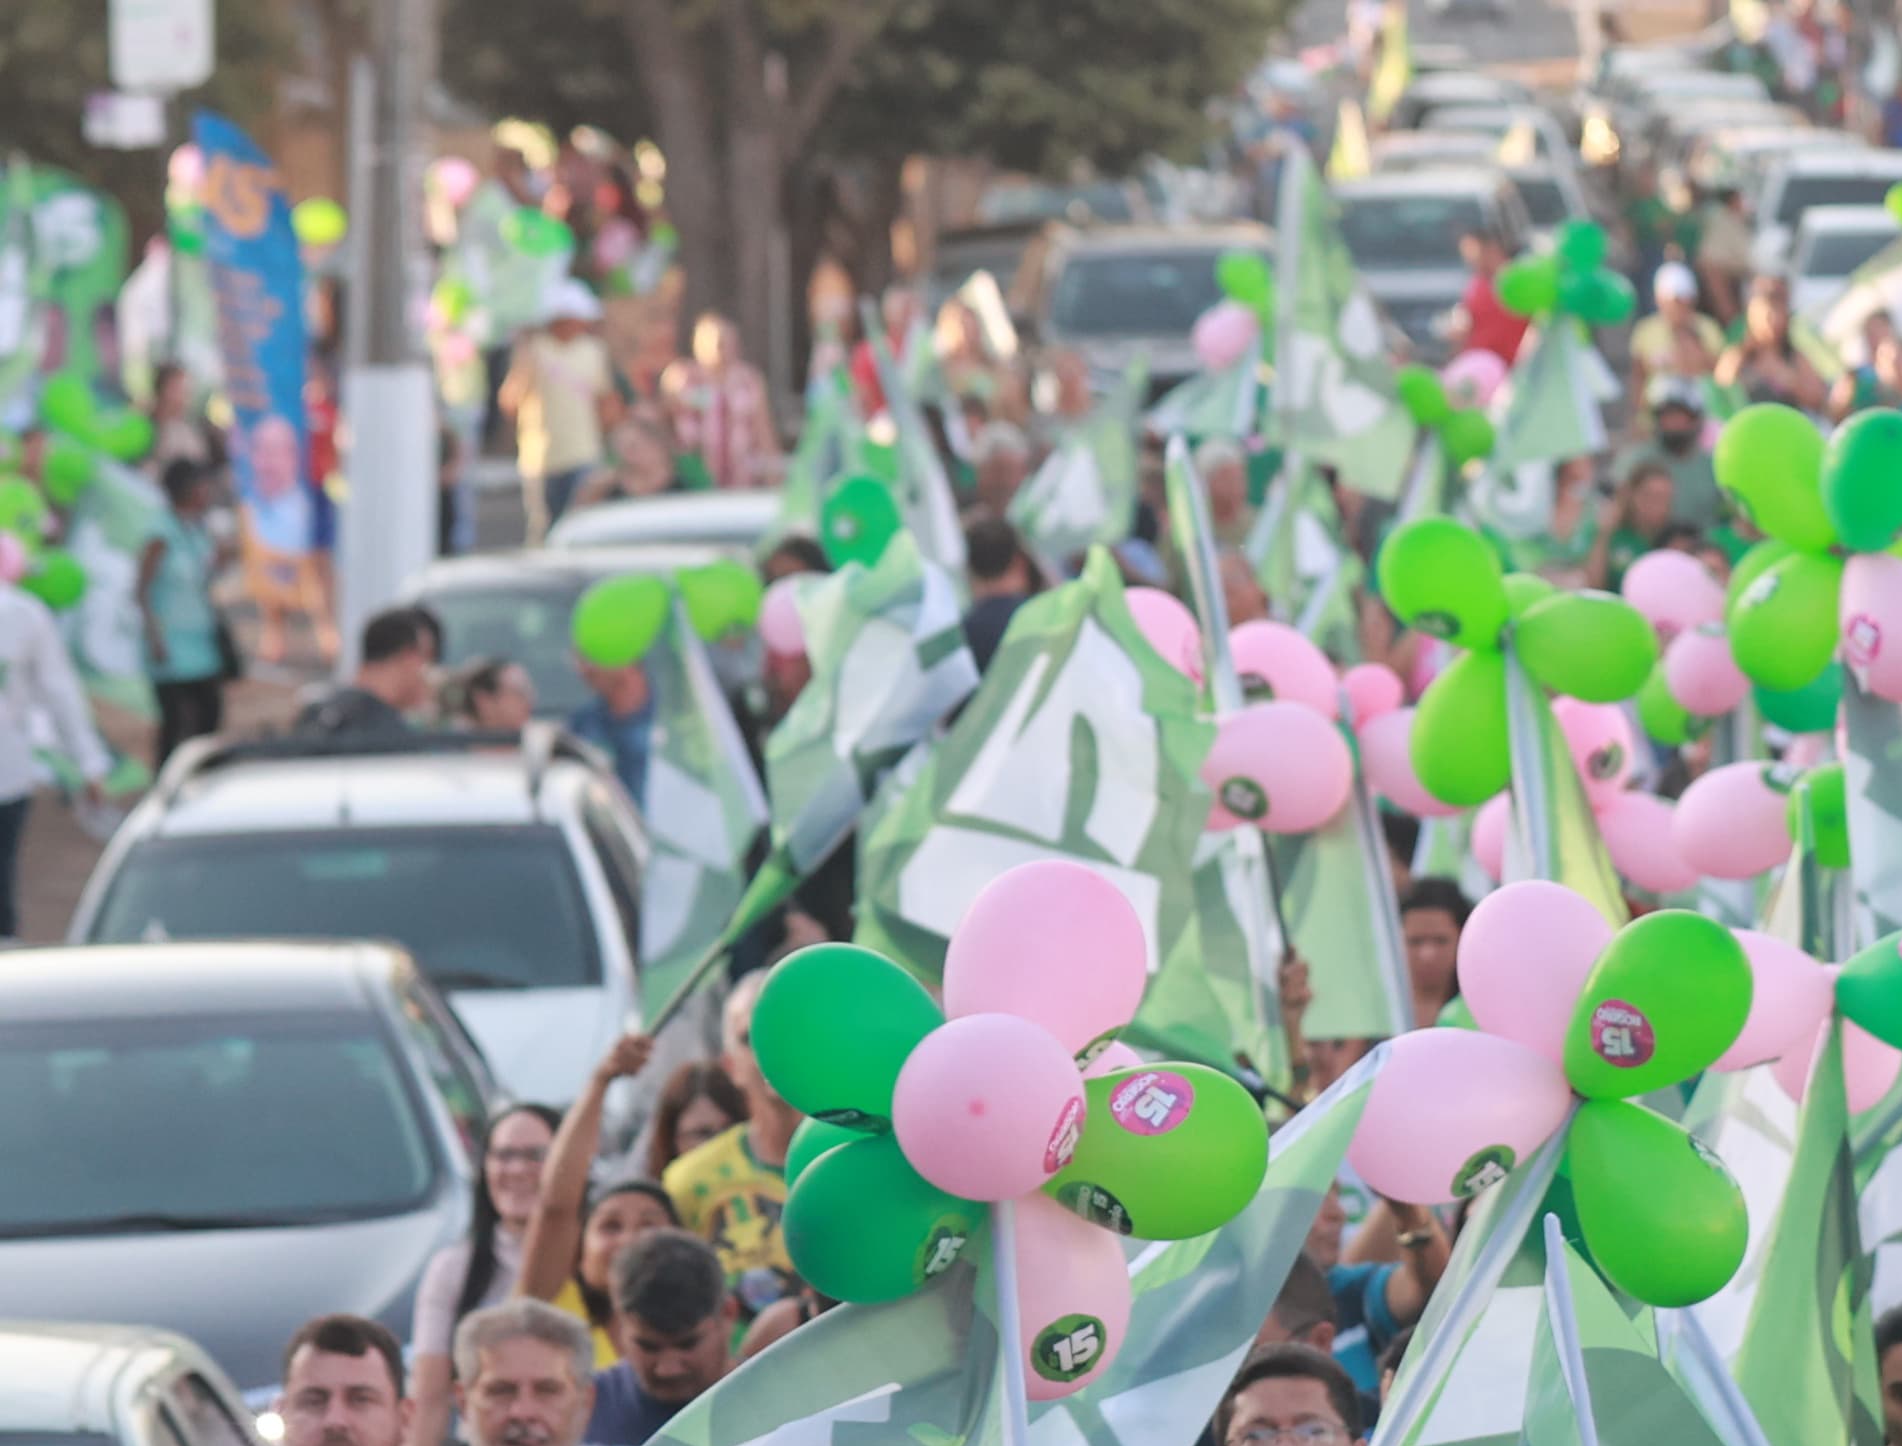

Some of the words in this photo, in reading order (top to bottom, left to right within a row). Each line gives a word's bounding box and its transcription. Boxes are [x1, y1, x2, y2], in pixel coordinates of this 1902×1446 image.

[1602, 1027, 1636, 1056] 15
[1134, 1086, 1178, 1128] 15
[925, 1236, 966, 1274] 15
[1053, 1324, 1099, 1372] 15
